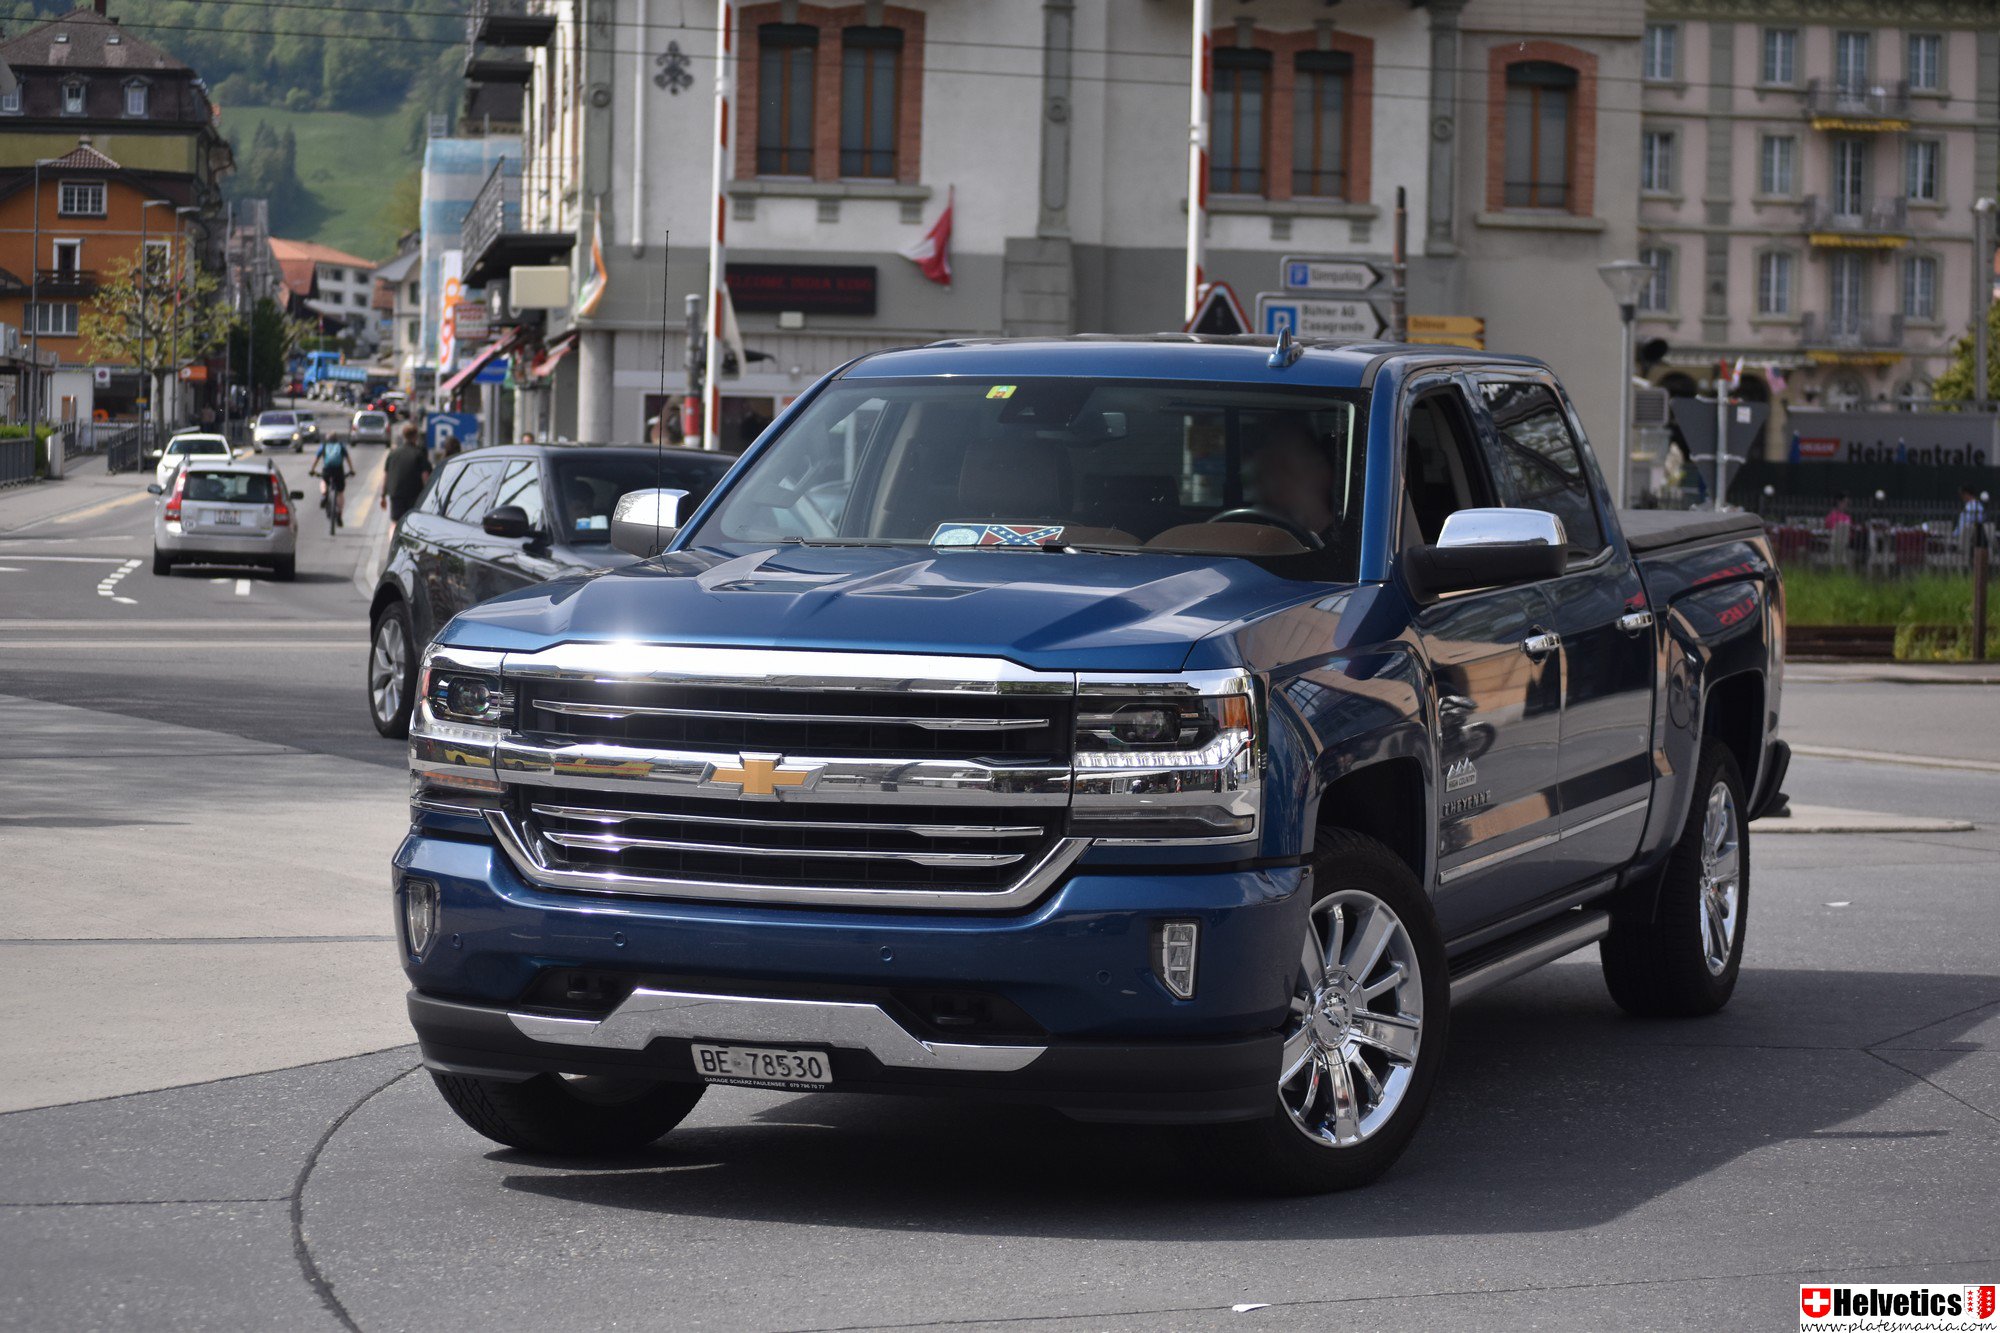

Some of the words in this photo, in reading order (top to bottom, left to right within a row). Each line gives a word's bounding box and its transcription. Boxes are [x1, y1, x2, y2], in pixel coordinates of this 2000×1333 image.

[1301, 319, 1365, 332] Casagrande
[1848, 440, 1986, 466] Heizentrale
[700, 1049, 732, 1074] BE
[745, 1052, 823, 1079] 78530
